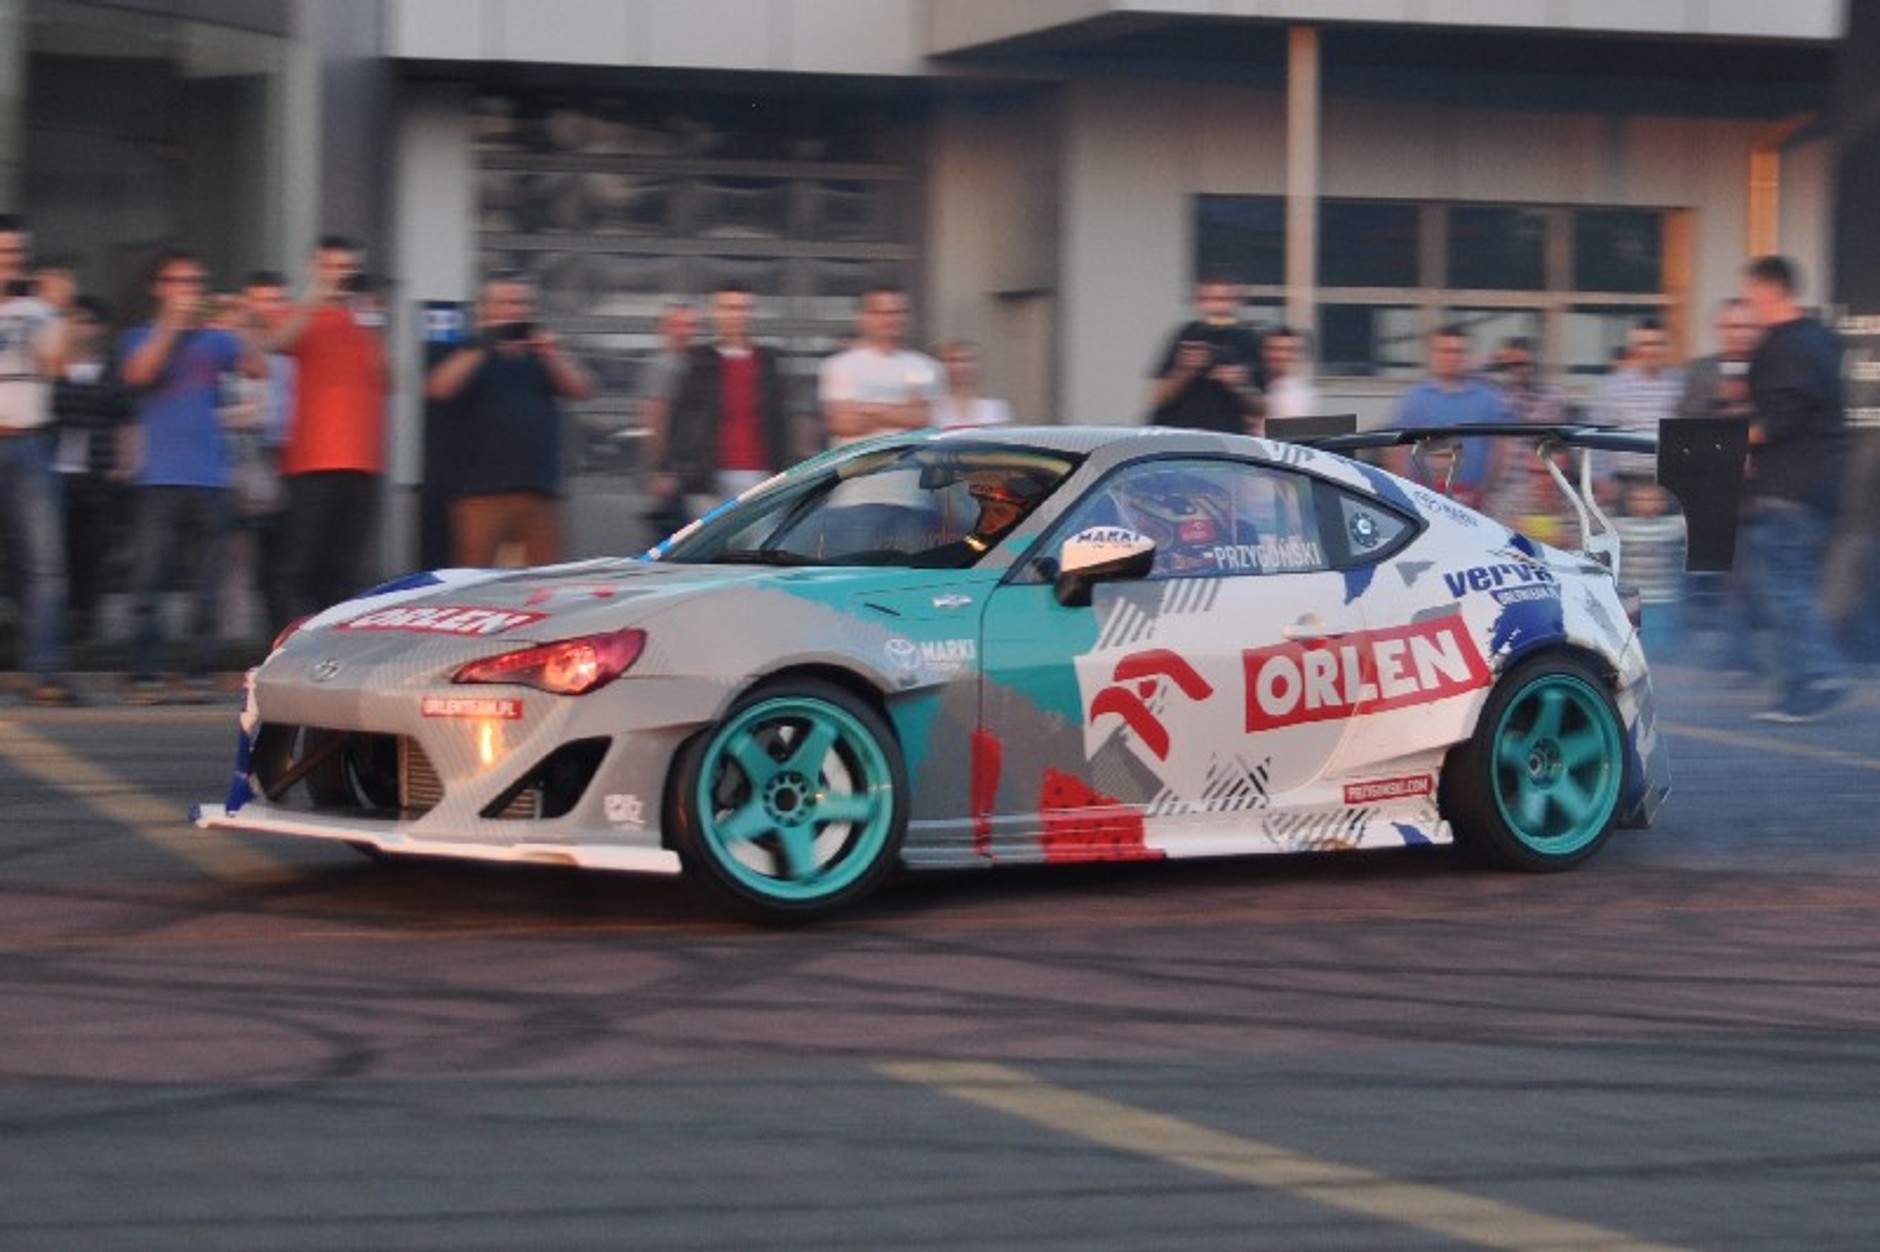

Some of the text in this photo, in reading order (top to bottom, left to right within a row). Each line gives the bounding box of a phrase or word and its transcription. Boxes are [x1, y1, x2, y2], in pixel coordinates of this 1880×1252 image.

[1077, 529, 1142, 544] MARKI
[350, 607, 532, 635] ORLEN
[920, 639, 976, 660] MARKI
[1256, 629, 1472, 716] ORLEN
